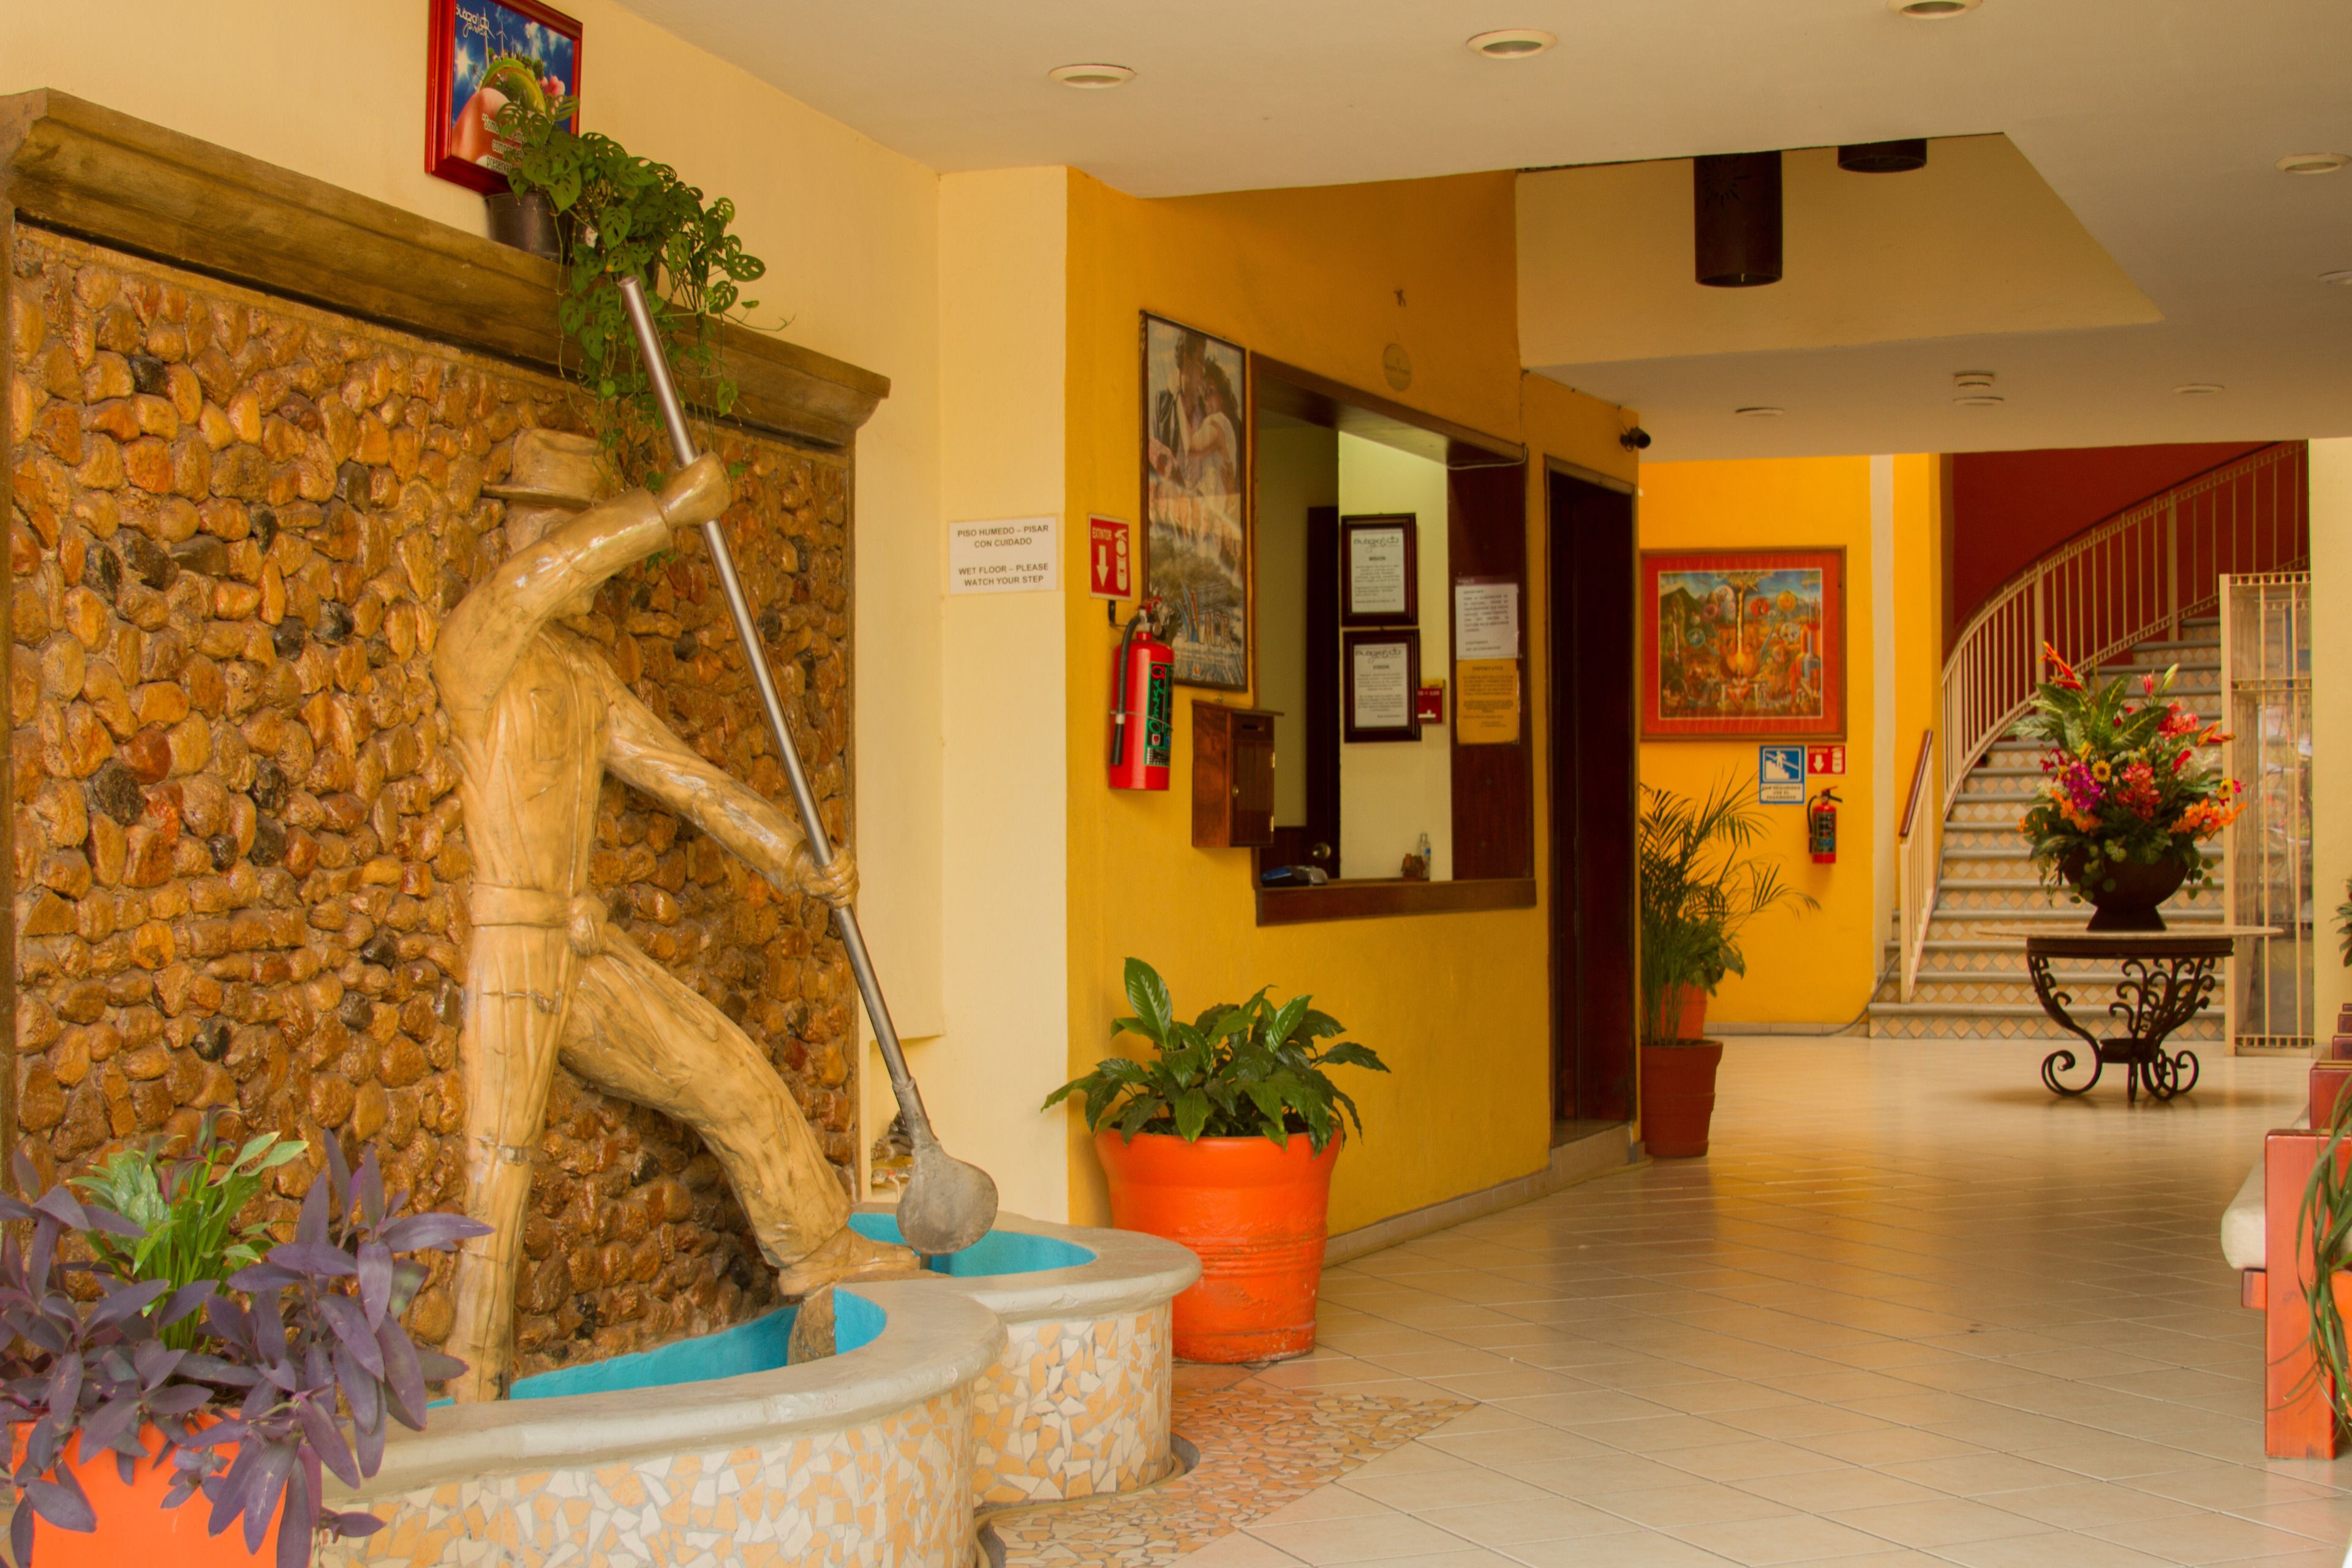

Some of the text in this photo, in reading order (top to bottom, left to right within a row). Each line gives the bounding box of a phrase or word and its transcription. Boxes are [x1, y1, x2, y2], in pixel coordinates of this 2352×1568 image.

[979, 527, 1015, 536] HUMEDO
[1023, 525, 1049, 533] PISAR
[1092, 527, 1112, 541] EXTINTOR
[974, 538, 1033, 548] CON CUIDADO
[979, 565, 1007, 574] FLOOR
[1016, 563, 1049, 572] PLEASE
[964, 578, 995, 587] WATCH
[997, 576, 1020, 585] YOUR
